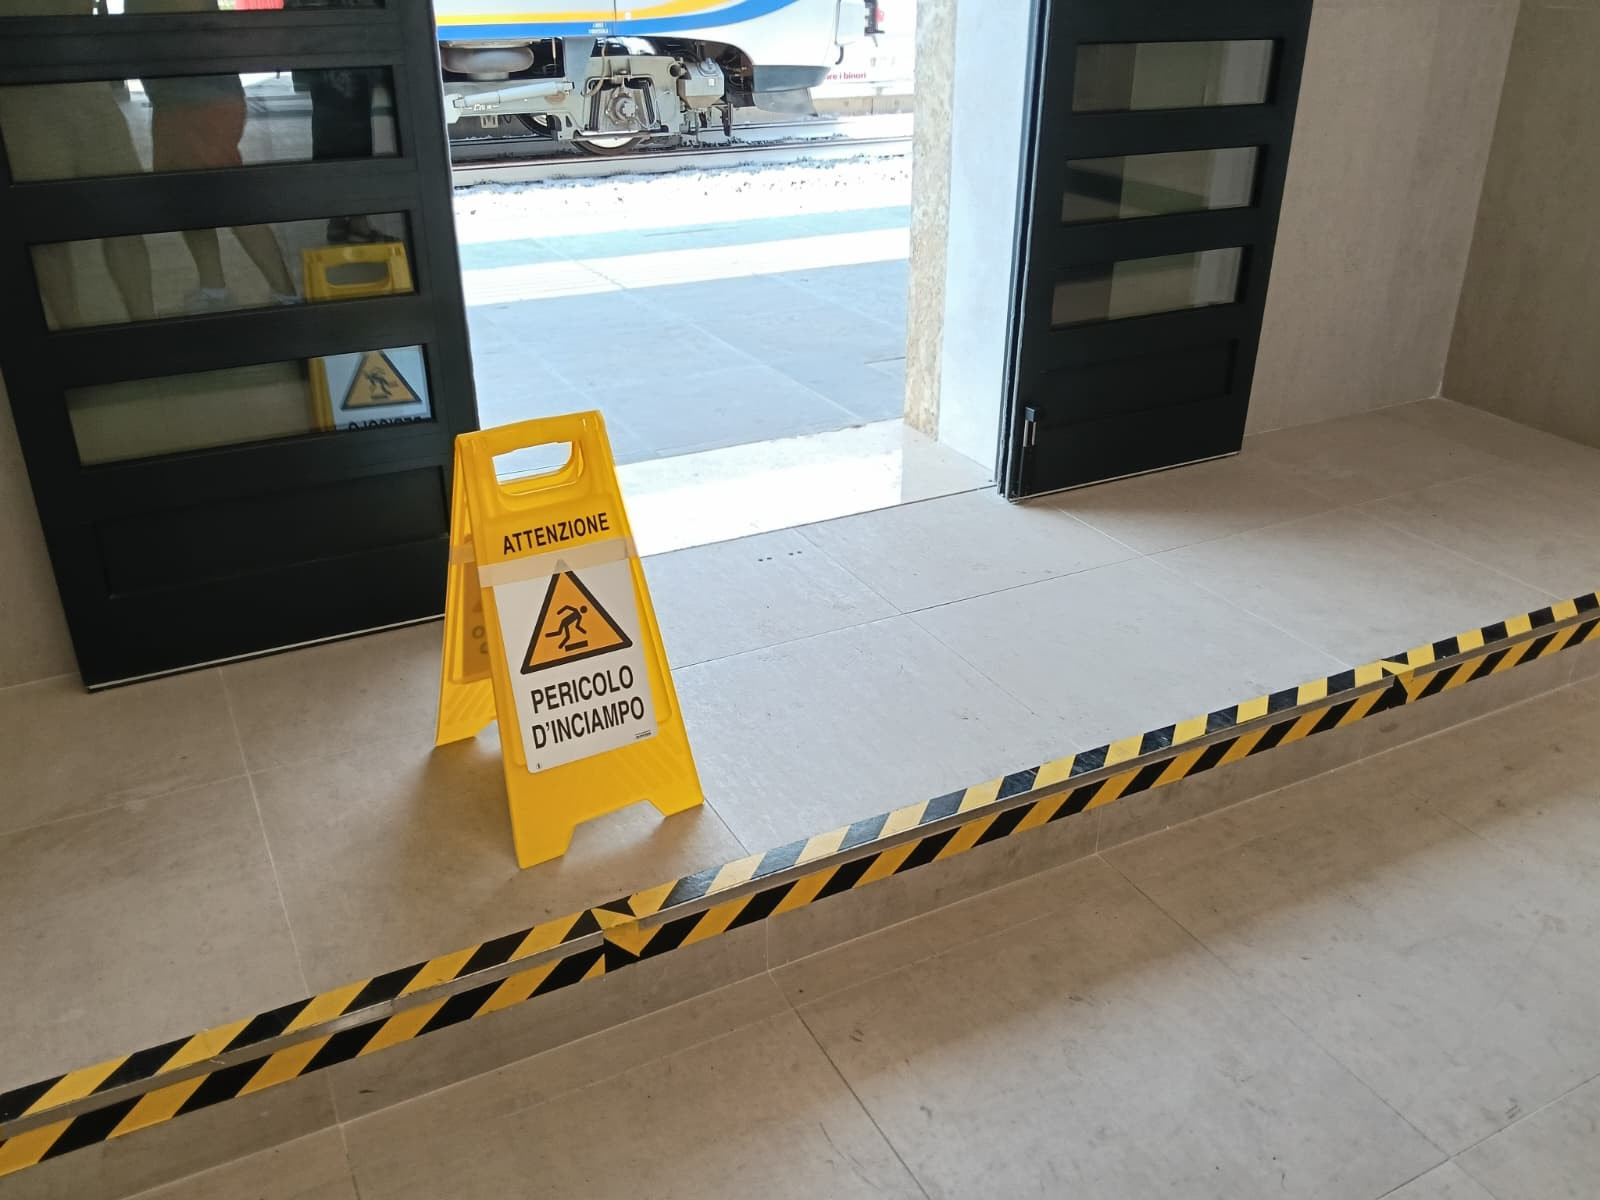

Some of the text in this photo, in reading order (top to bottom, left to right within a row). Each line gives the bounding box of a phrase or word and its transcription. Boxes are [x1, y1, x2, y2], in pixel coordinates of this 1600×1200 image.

[503, 512, 610, 555] ATTENZIONE
[530, 665, 634, 714] PERICOLO
[531, 696, 645, 750] D'INCIAMPO
